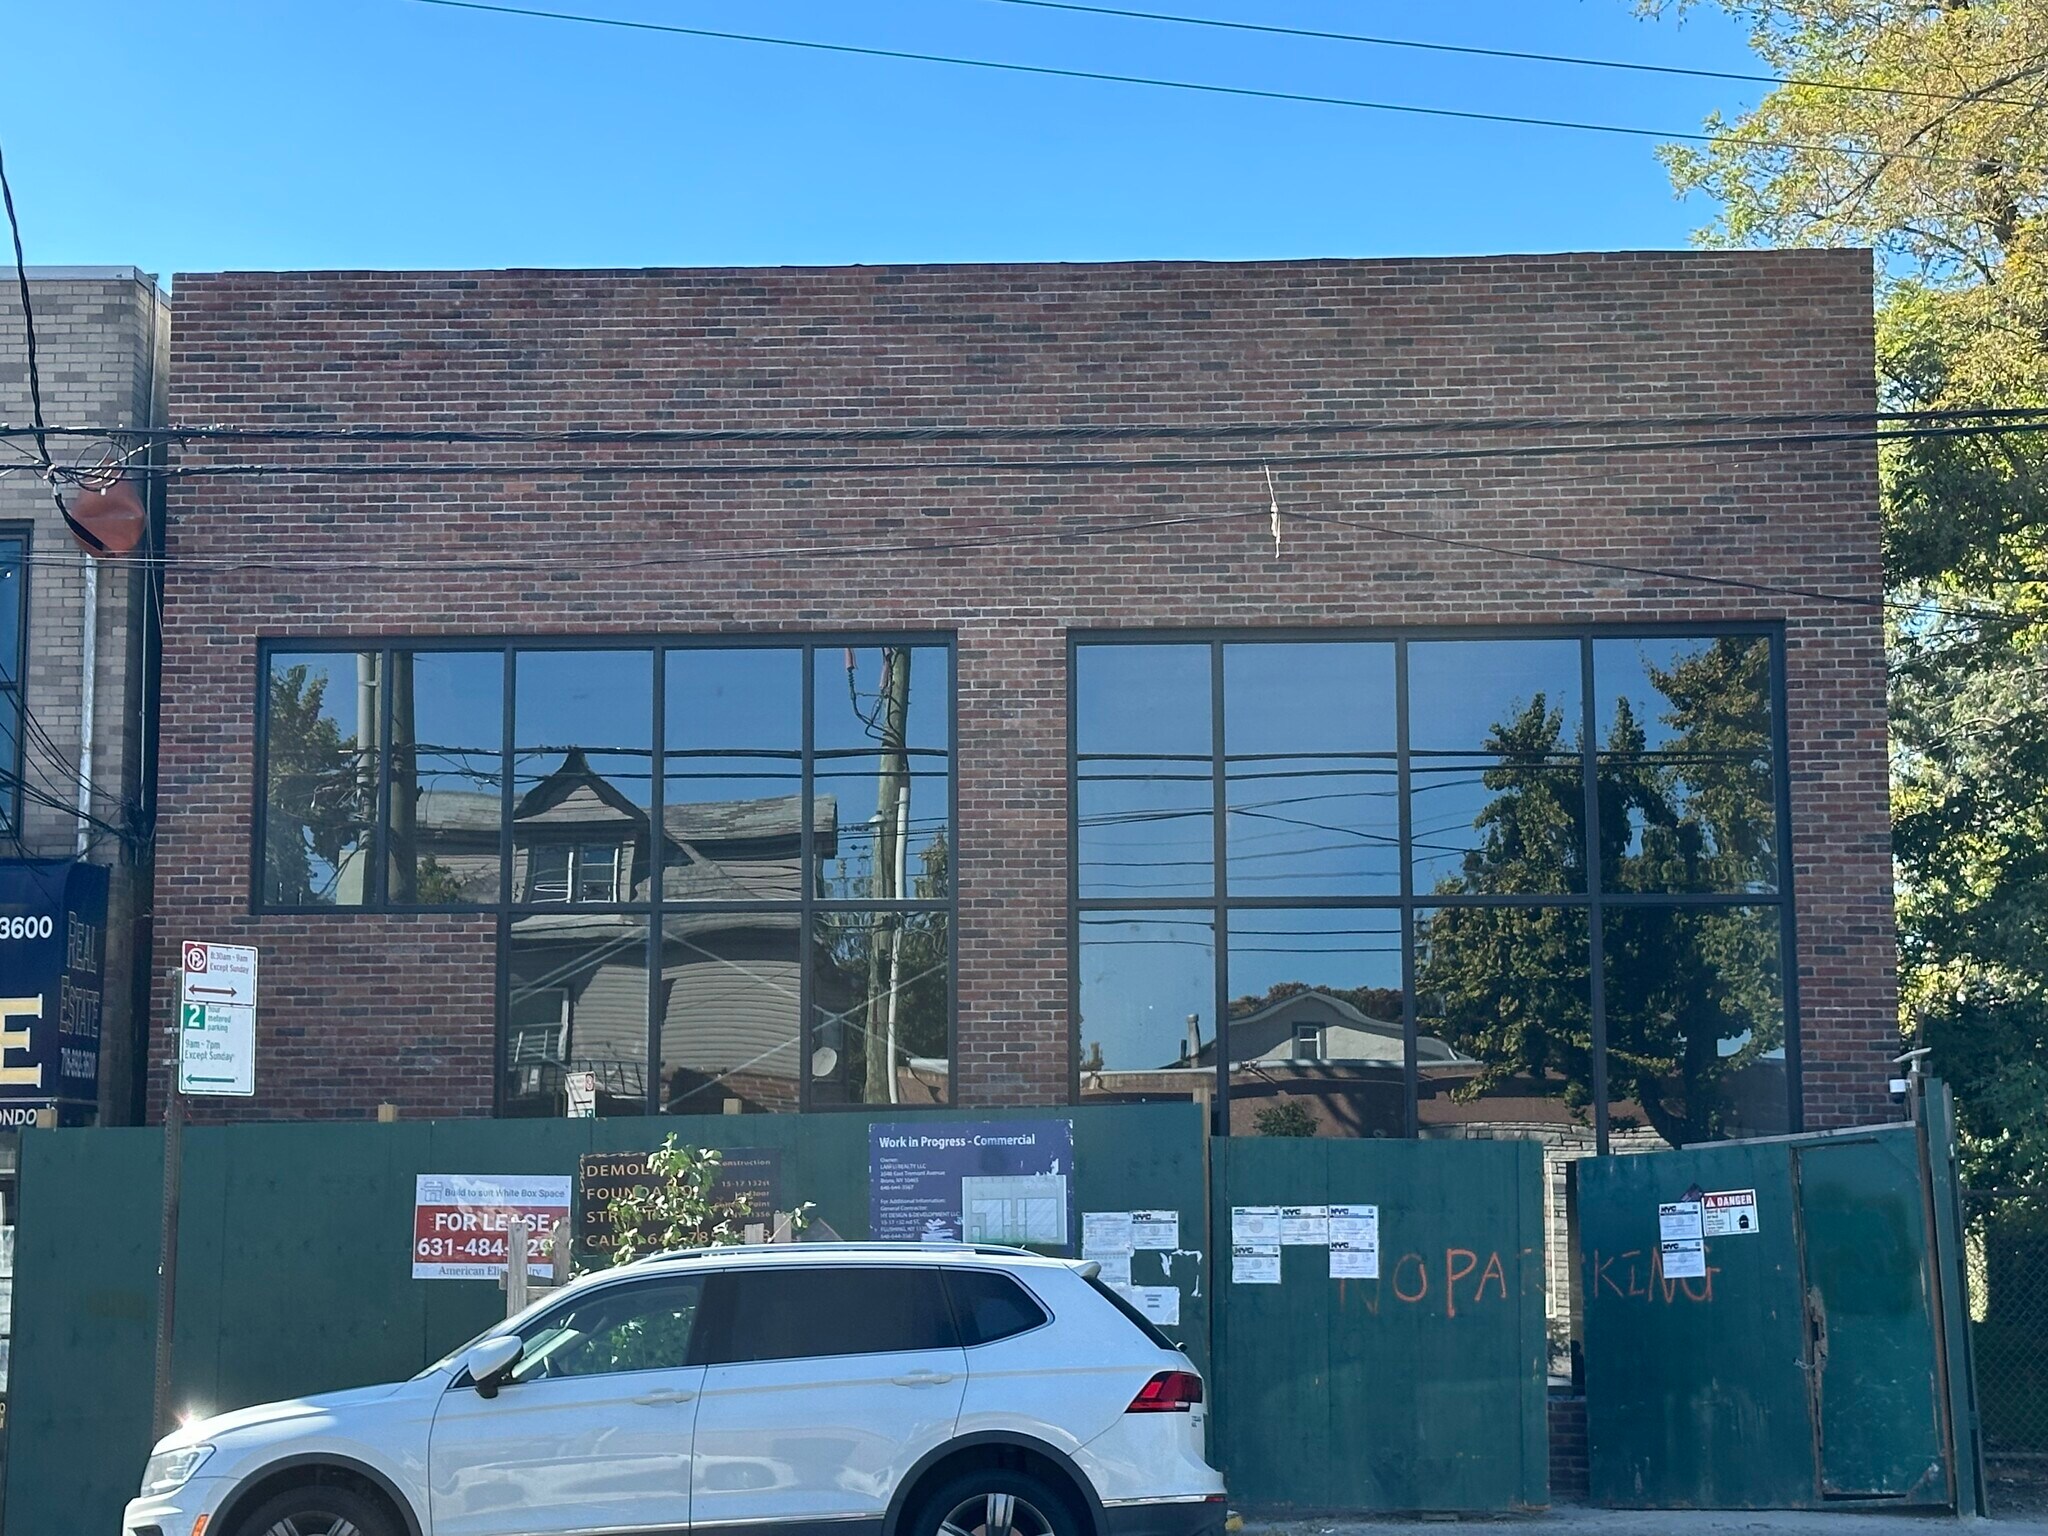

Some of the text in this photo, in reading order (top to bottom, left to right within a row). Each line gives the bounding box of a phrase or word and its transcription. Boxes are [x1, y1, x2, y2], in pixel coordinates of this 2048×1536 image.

[0, 916, 53, 939] 3600
[210, 963, 249, 975] Except Sunday
[58, 975, 99, 1038] ESTATE
[188, 1004, 200, 1028] 2
[208, 1015, 231, 1023] metered
[208, 1024, 228, 1033] parking
[185, 1039, 200, 1049] 9am
[206, 1040, 220, 1051] 7pm
[185, 1050, 234, 1062] Except Sunday
[879, 1136, 907, 1148] Work
[908, 1136, 919, 1148] in
[920, 1136, 966, 1150] Progress
[974, 1133, 1035, 1147] Commercial
[721, 1160, 771, 1168] onstruction
[468, 1187, 477, 1197] to
[497, 1187, 520, 1197] White
[521, 1189, 537, 1198] Box
[538, 1189, 565, 1200] Space
[1716, 1194, 1753, 1207] DANGER
[1132, 1213, 1152, 1221] NYC
[1282, 1208, 1301, 1216] NYC
[435, 1213, 477, 1232] FOR
[438, 1266, 485, 1277] American
